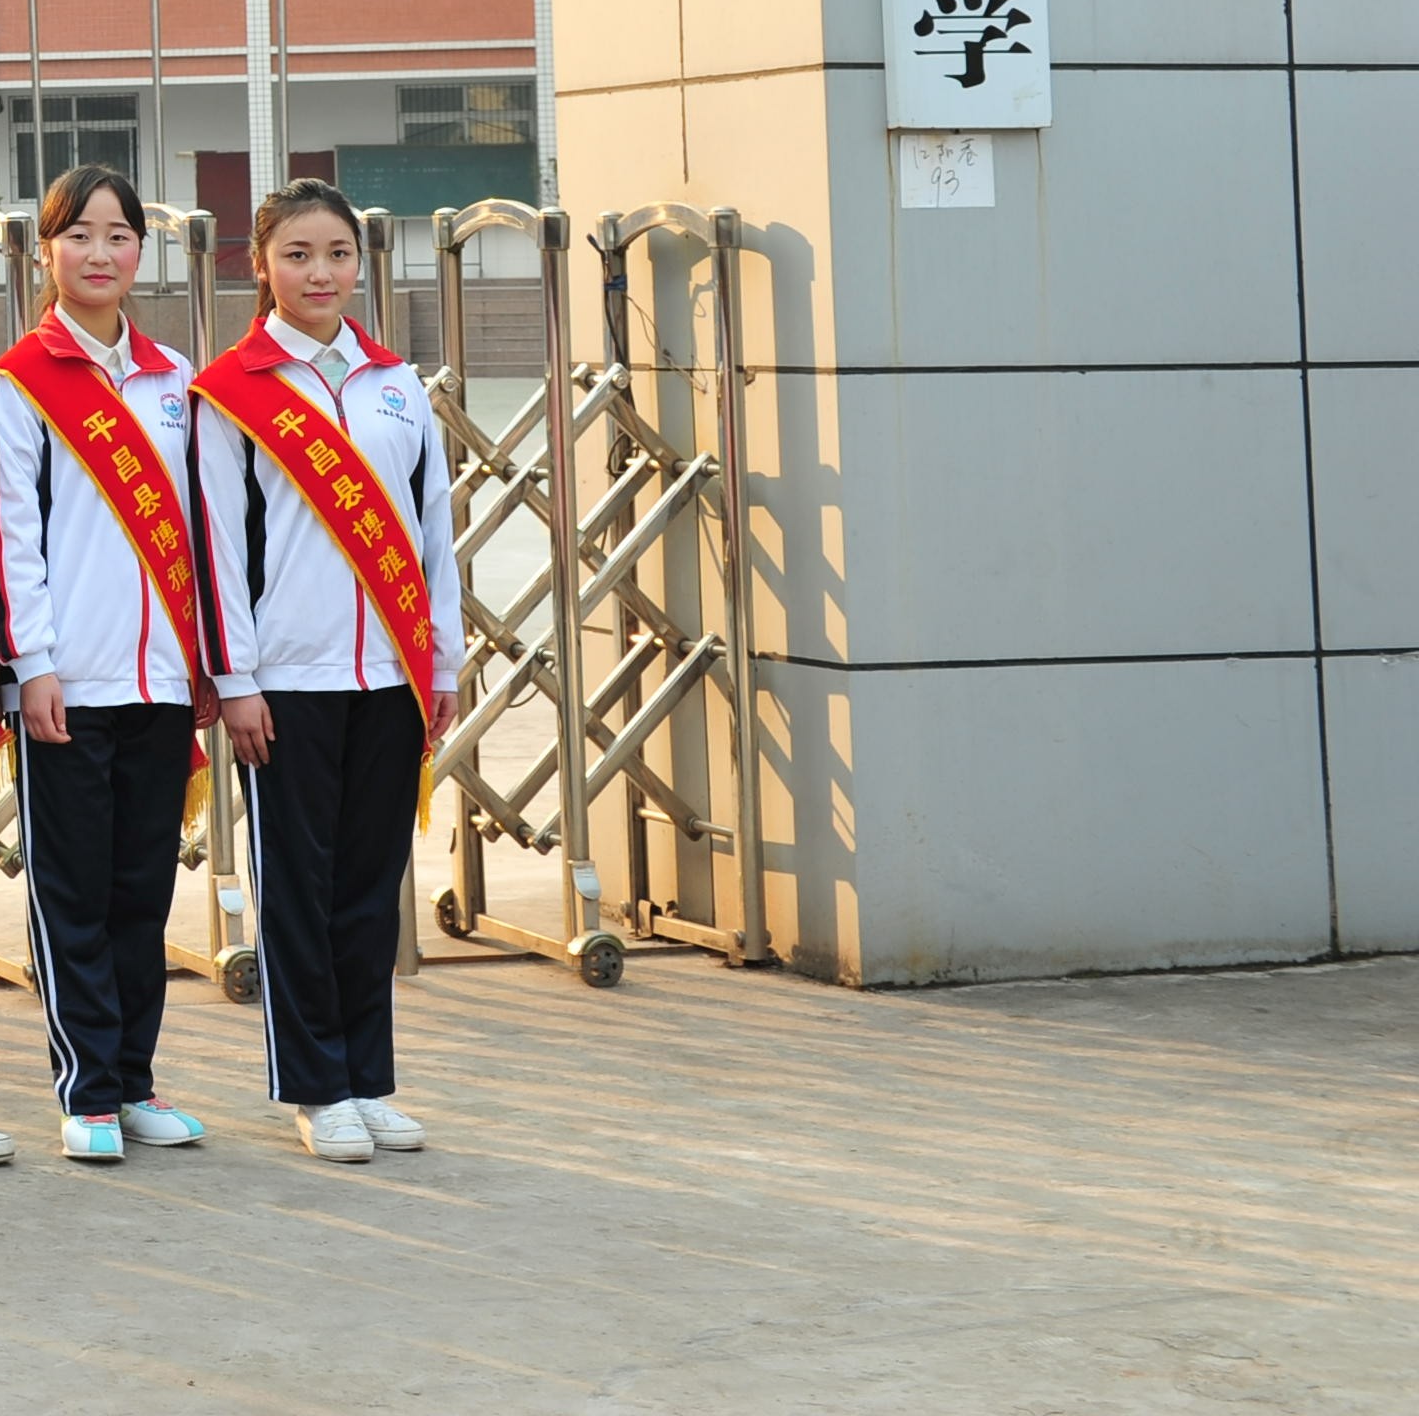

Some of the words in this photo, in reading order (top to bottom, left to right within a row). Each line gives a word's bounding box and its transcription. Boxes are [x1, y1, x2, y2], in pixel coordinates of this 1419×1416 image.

[272, 408, 431, 652] 平昌县博雅中学
